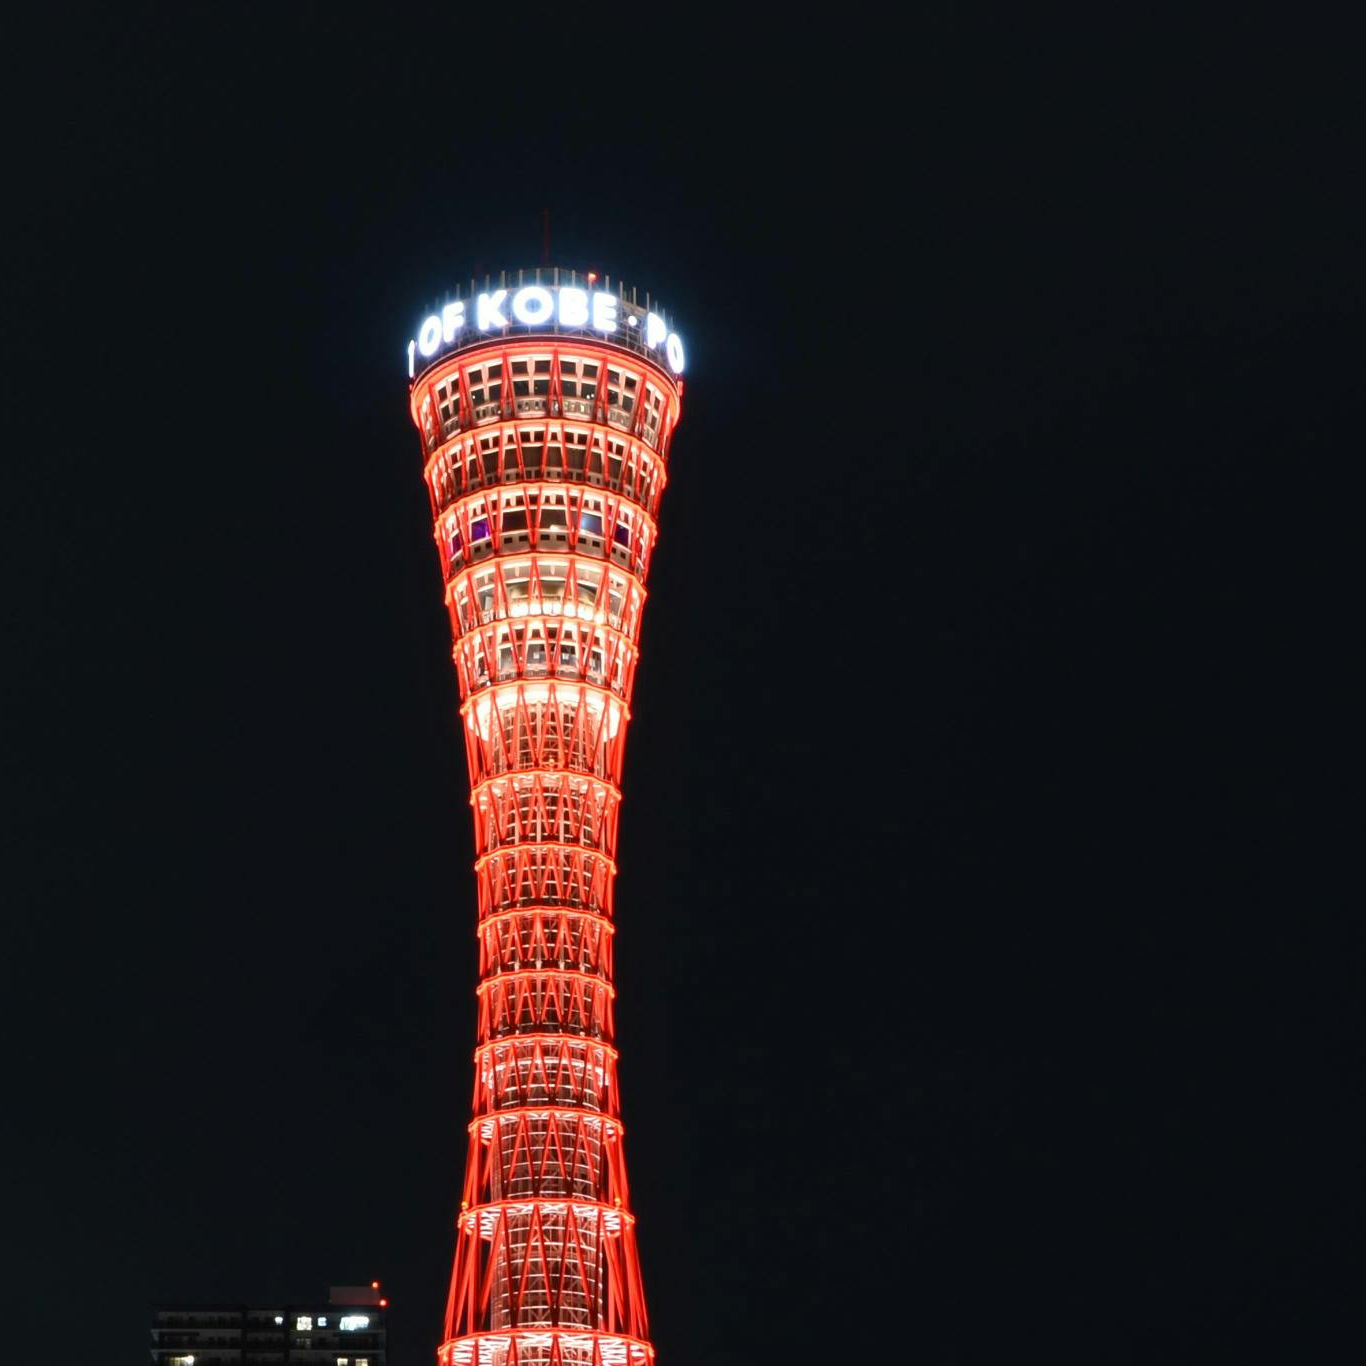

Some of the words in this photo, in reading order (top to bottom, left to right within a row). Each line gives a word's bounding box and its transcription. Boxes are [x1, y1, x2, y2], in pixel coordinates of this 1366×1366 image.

[419, 301, 464, 356] OF
[477, 286, 619, 333] KOBE
[647, 312, 685, 374] PO
